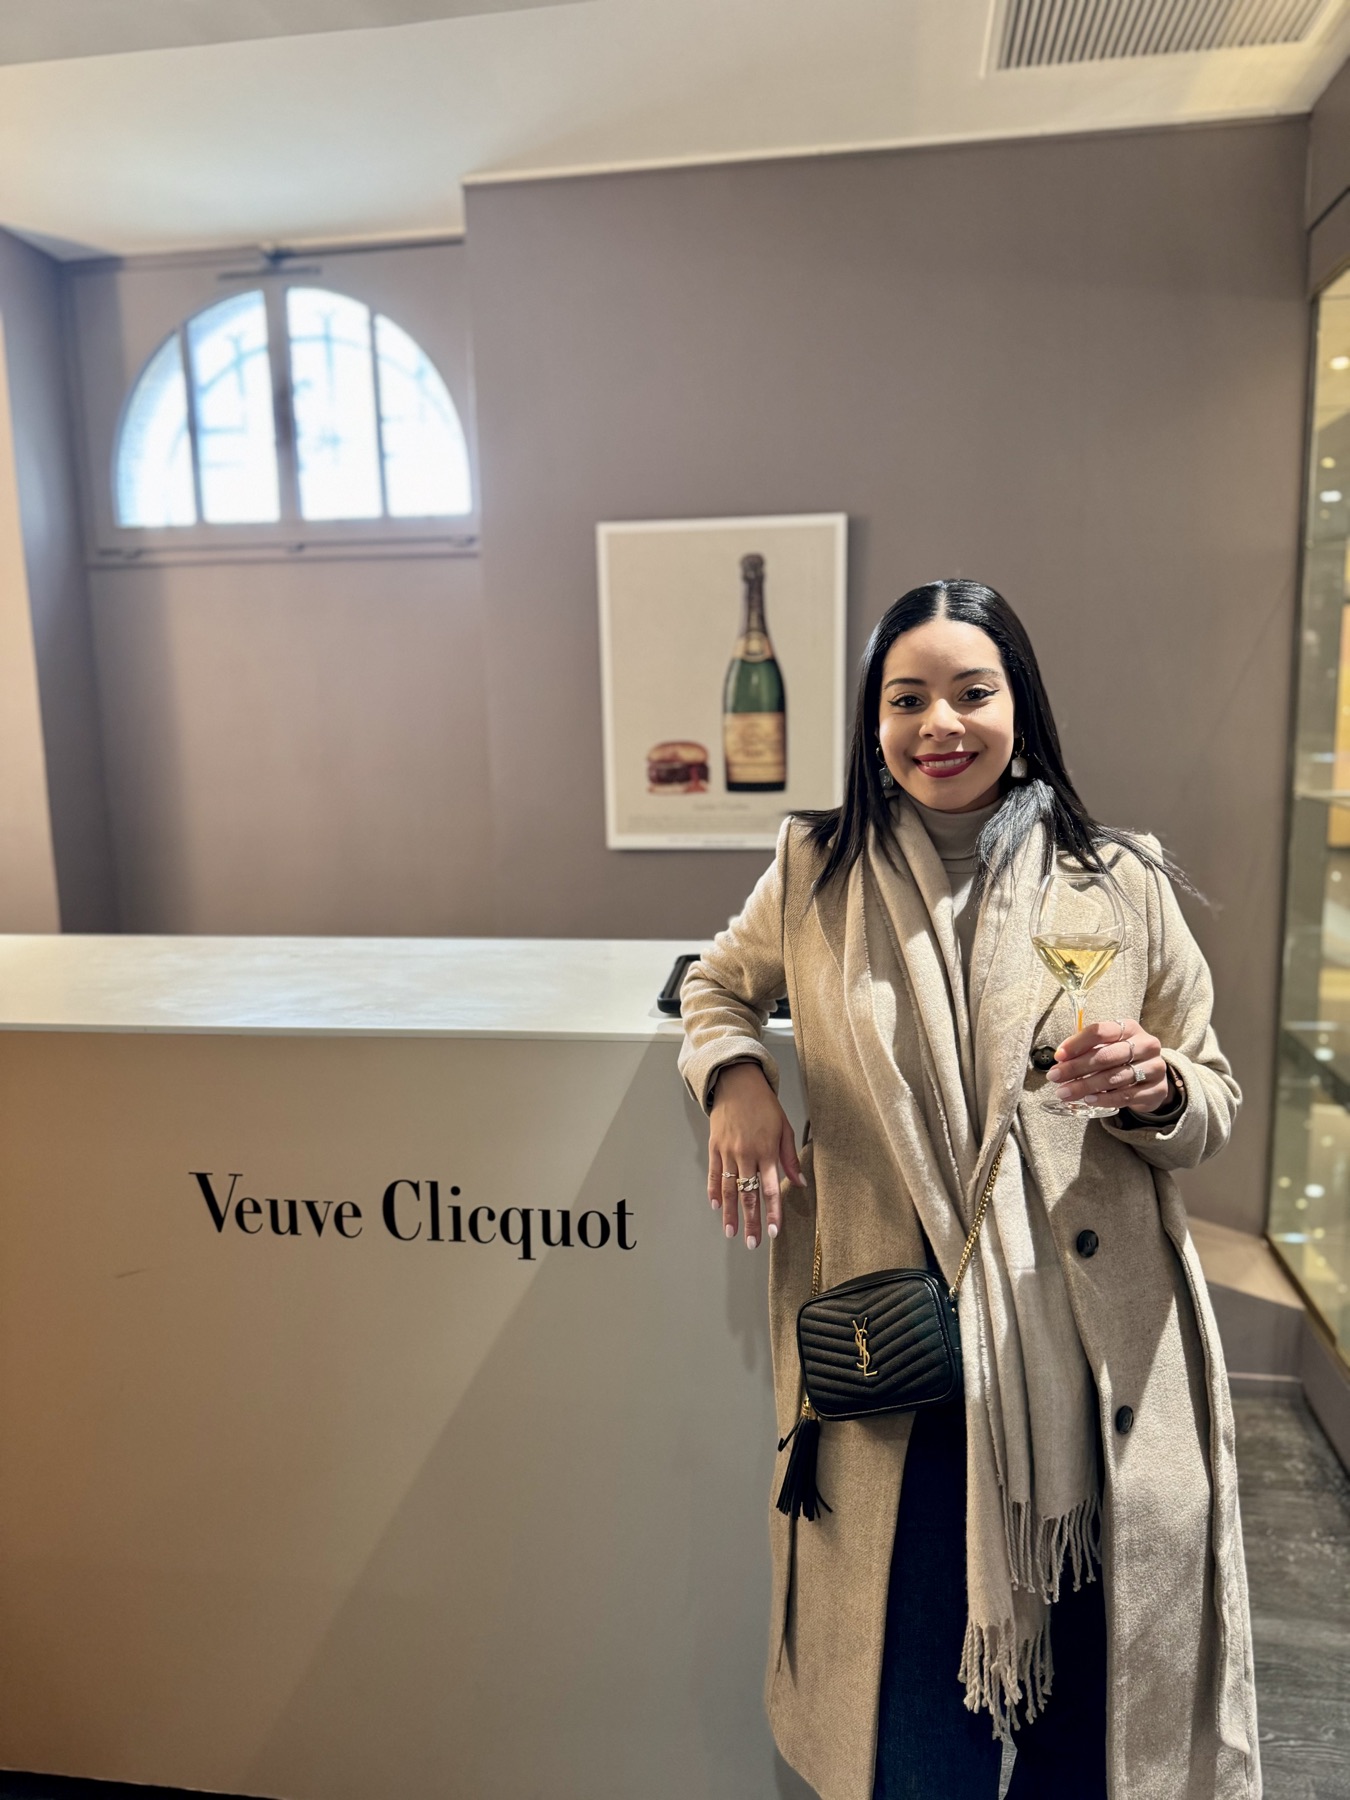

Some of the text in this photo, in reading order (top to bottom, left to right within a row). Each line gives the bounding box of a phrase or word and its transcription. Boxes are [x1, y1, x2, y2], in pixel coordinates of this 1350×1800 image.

[188, 1172, 637, 1261] Veuve Clicquot
[853, 1317, 878, 1377] YSL
